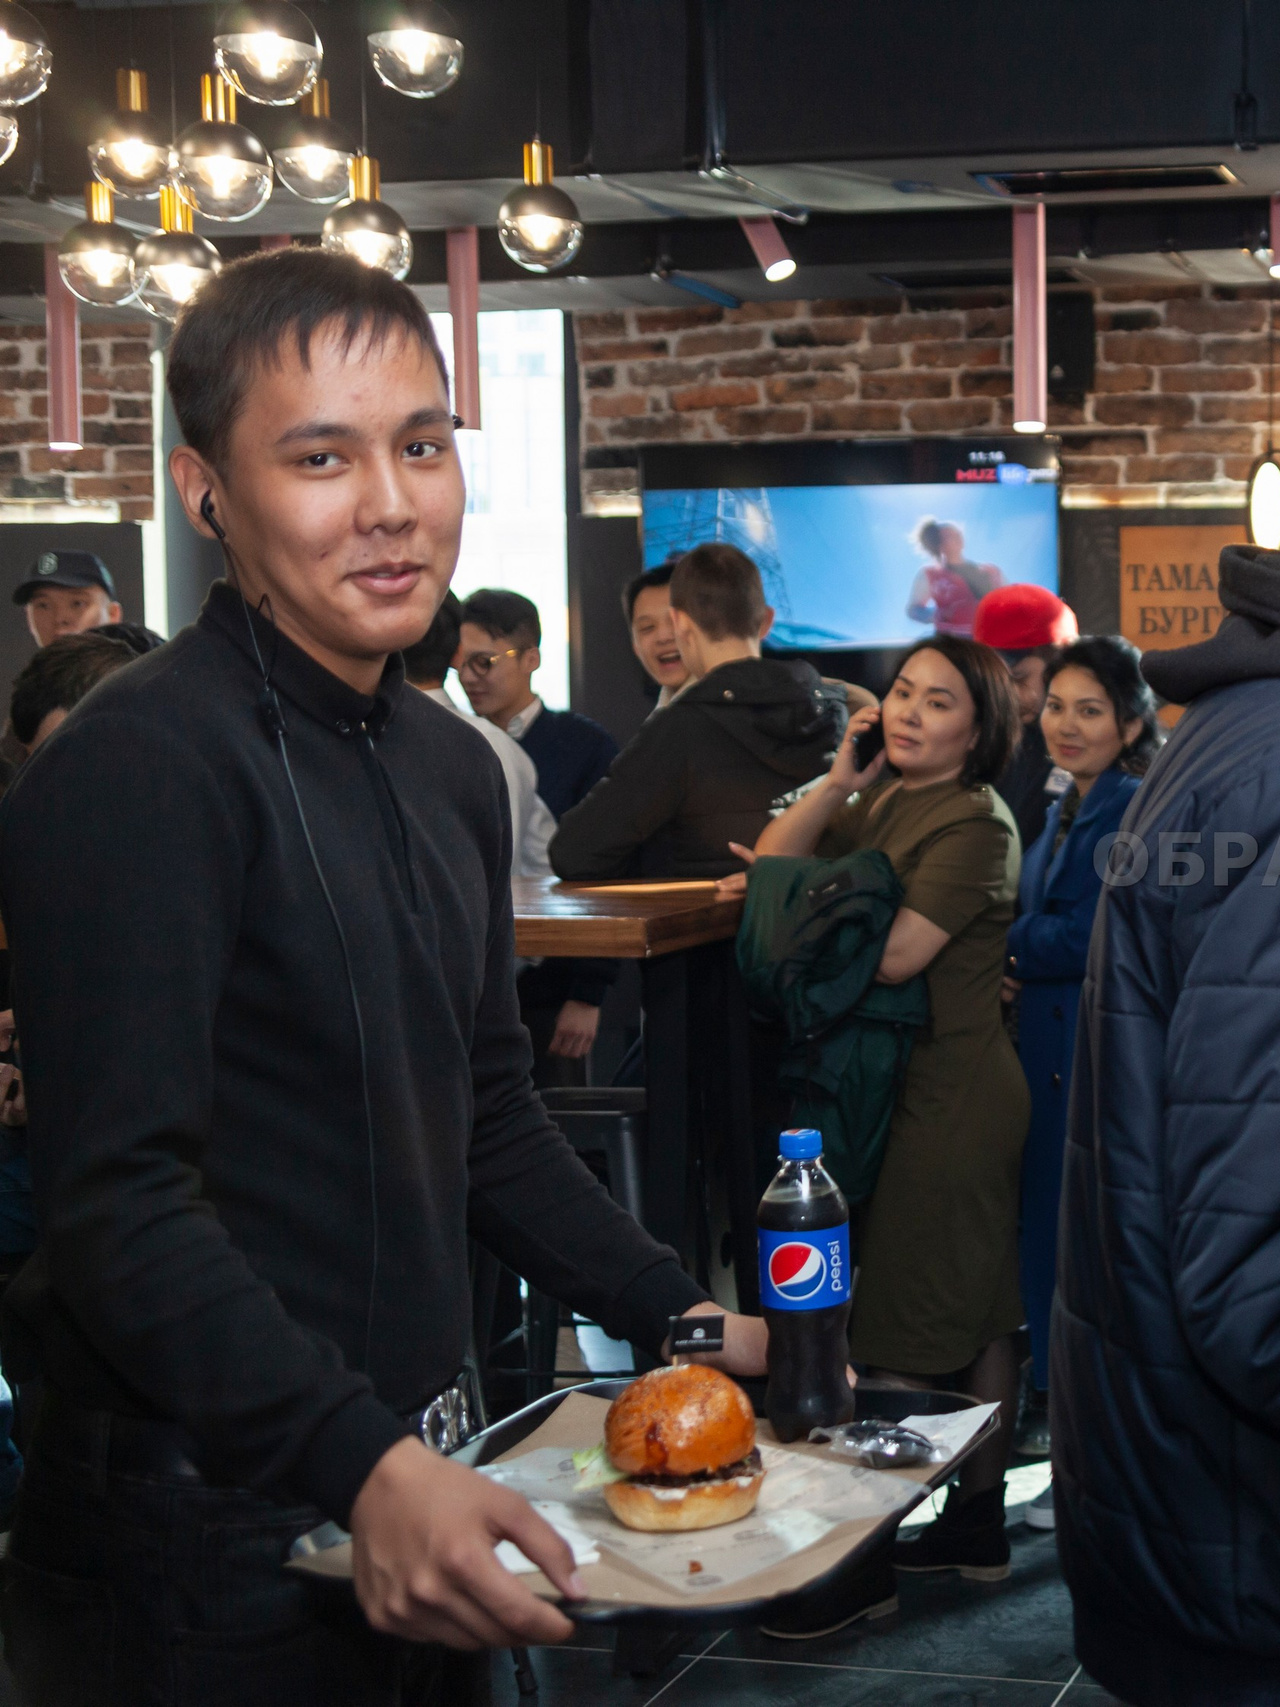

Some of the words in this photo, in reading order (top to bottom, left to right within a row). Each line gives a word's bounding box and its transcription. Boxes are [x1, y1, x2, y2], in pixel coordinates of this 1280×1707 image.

[1126, 563, 1215, 591] ТАМА
[1138, 606, 1229, 635] БУРГ
[827, 1240, 843, 1292] pepsi
